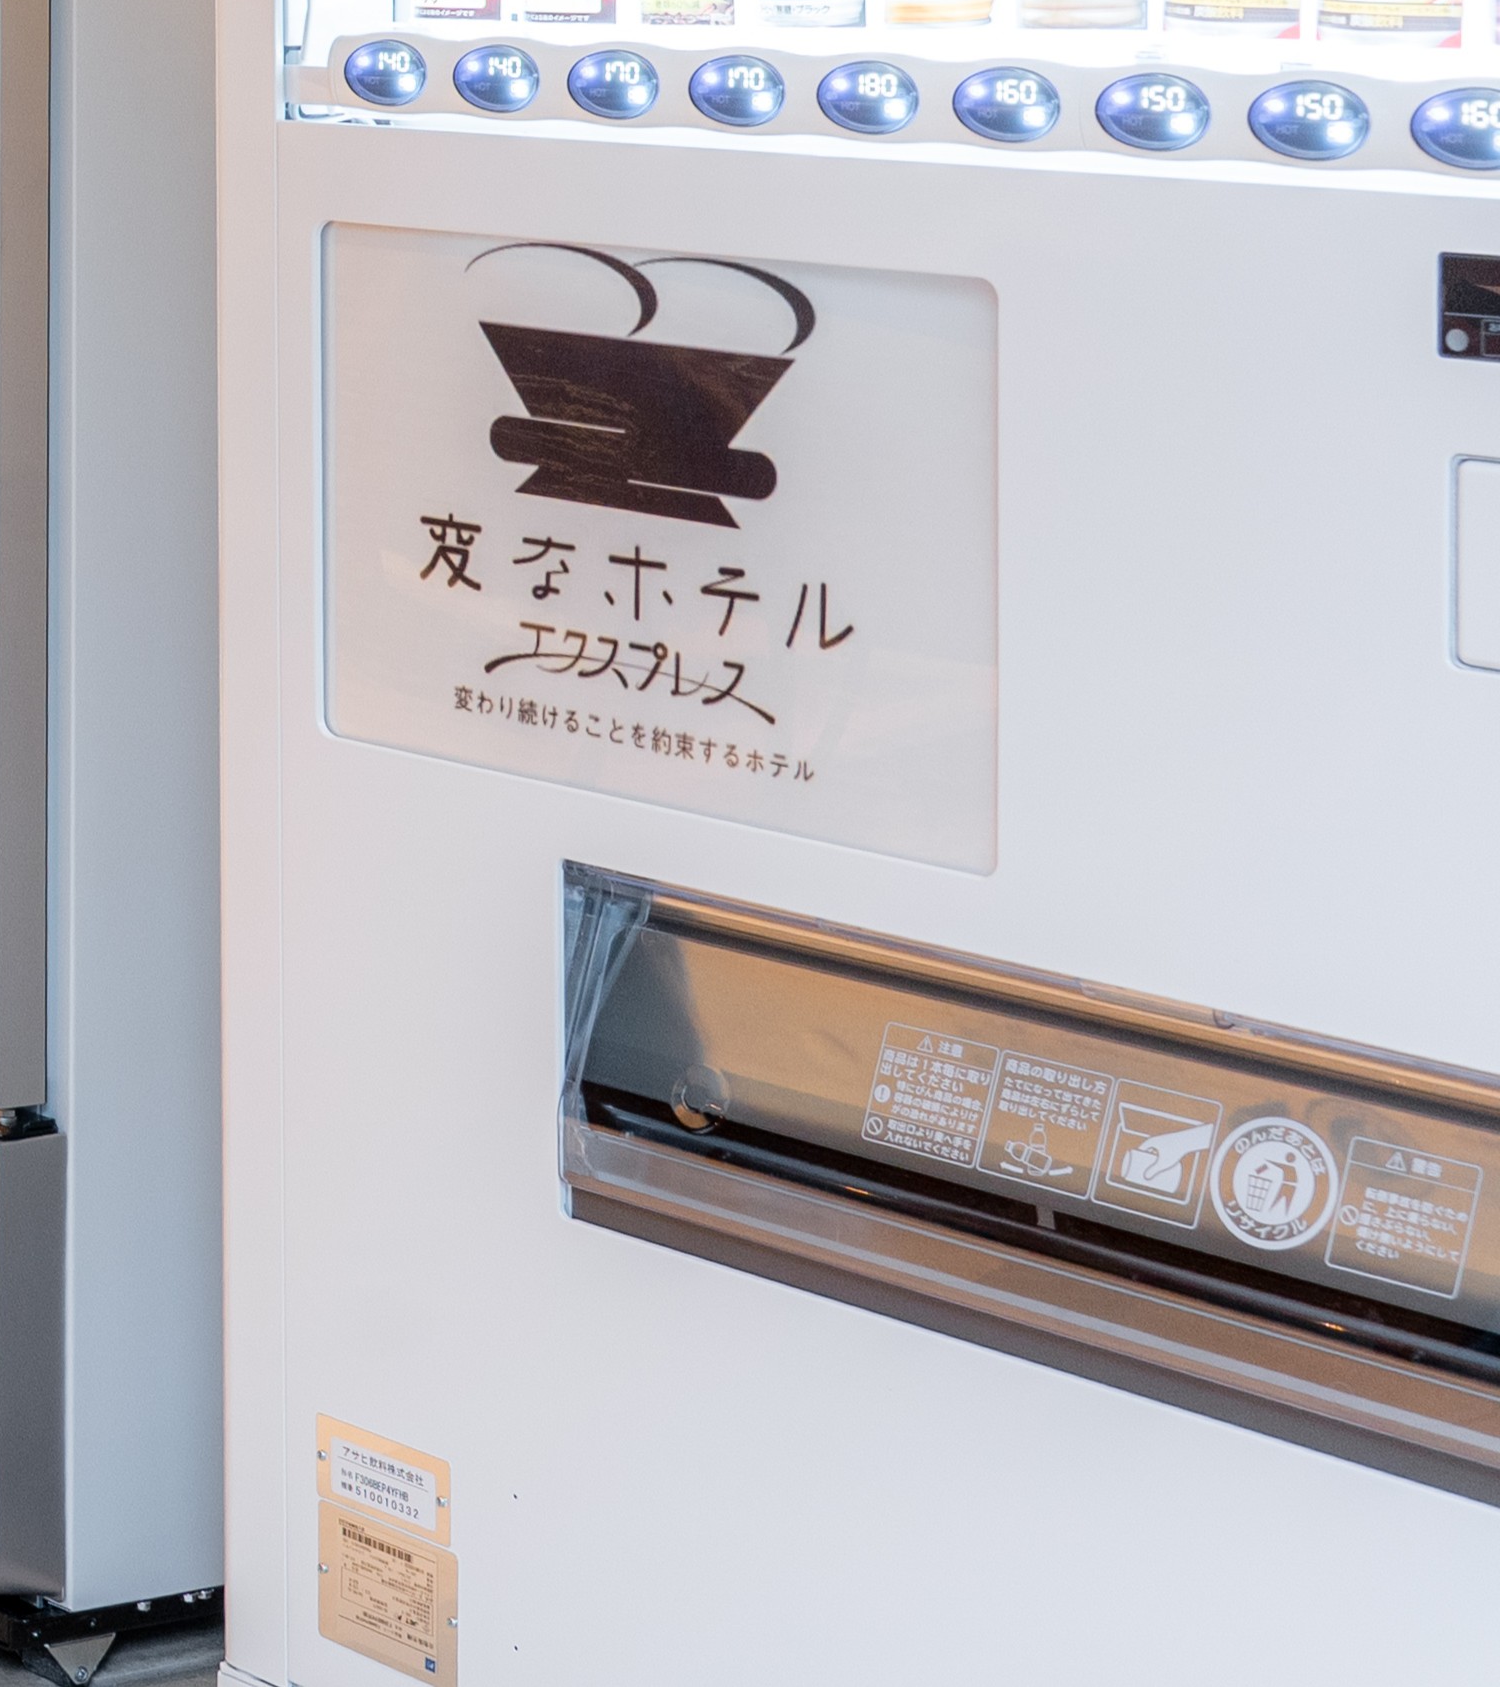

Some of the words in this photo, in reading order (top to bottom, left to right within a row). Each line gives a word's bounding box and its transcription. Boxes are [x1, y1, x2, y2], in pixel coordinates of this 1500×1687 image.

[378, 51, 410, 73] 140
[488, 56, 522, 79] 140
[858, 73, 898, 98] 180
[995, 78, 1037, 105] 160
[1141, 85, 1186, 112] 150
[1295, 92, 1344, 120] 150
[419, 512, 855, 651] 変なホテル
[484, 620, 776, 726] エクスプレス
[453, 685, 815, 782] 変わり続けることを約束するホテル
[1234, 1126, 1327, 1176] のんだあとは
[1225, 1199, 1308, 1240] リサイクル
